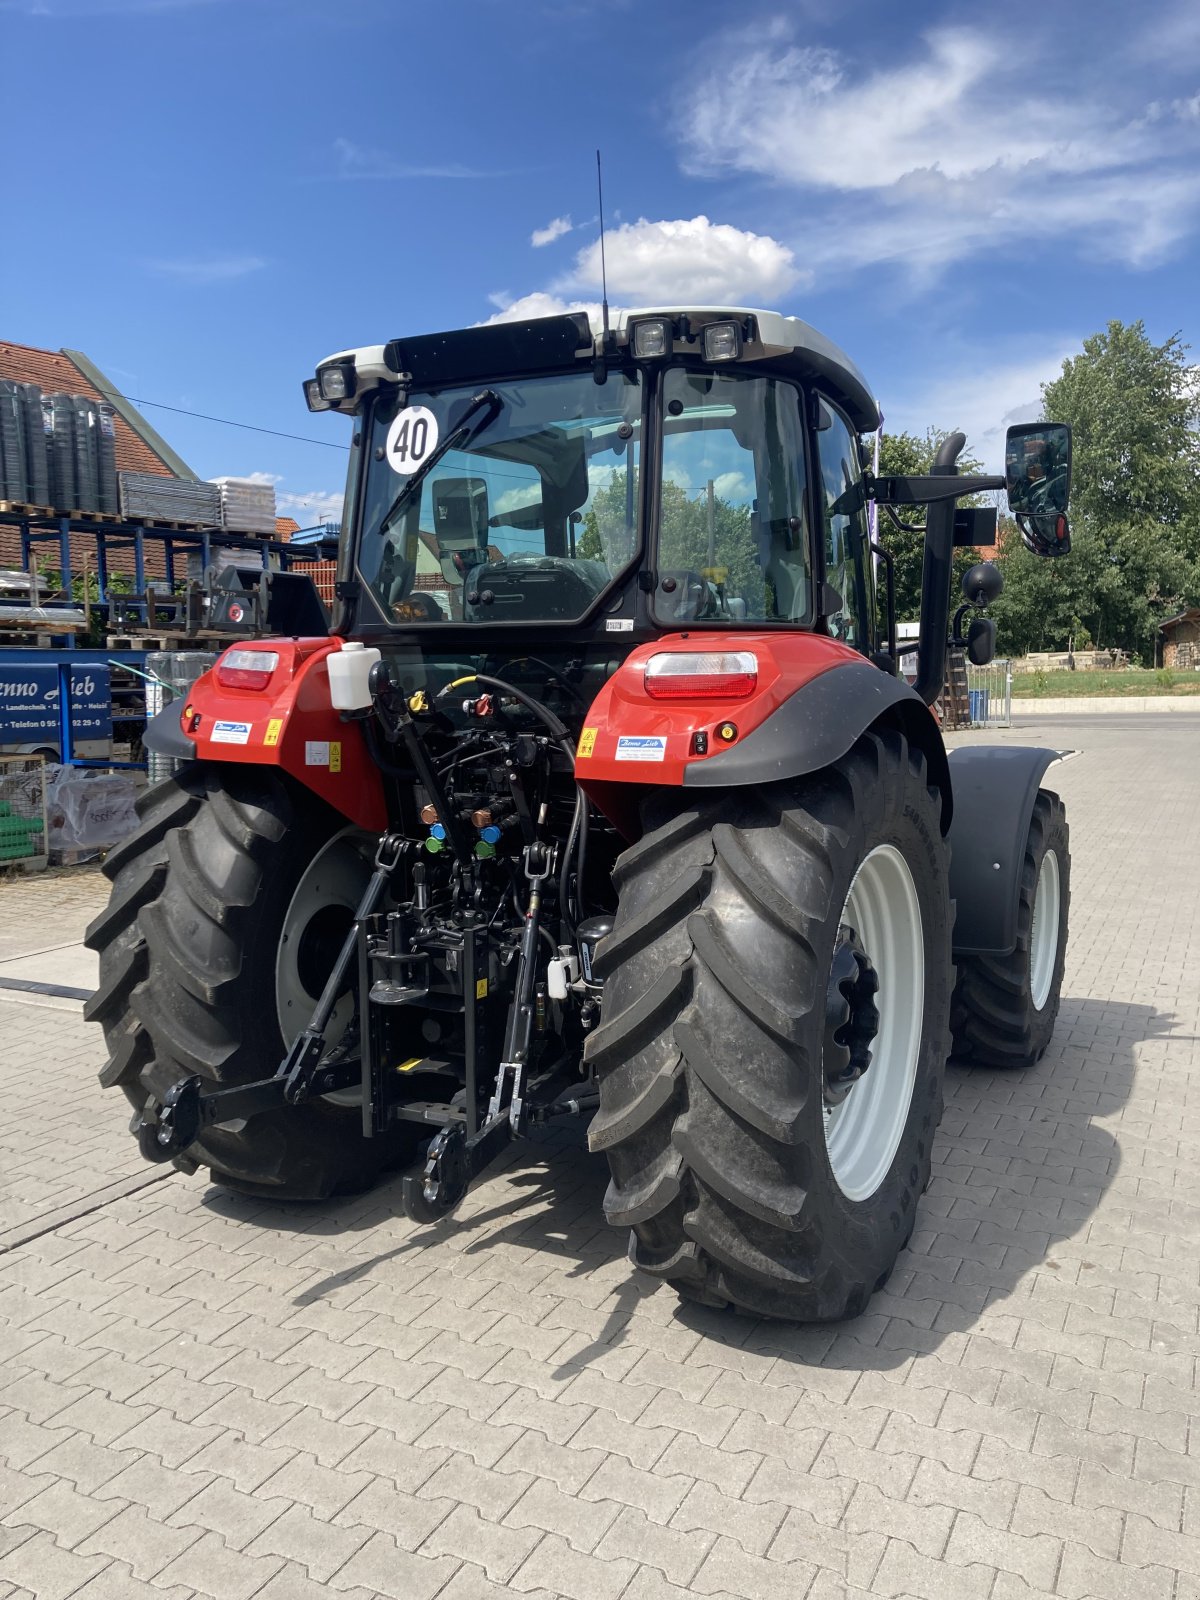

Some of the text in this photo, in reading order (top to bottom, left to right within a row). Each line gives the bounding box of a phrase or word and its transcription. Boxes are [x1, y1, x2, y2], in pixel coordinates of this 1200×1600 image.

[393, 417, 429, 463] 40
[44, 675, 95, 700] ieb
[5, 703, 47, 711] Landtechnik
[10, 720, 39, 728] Telefon
[621, 739, 659, 748] Benno Lieb
